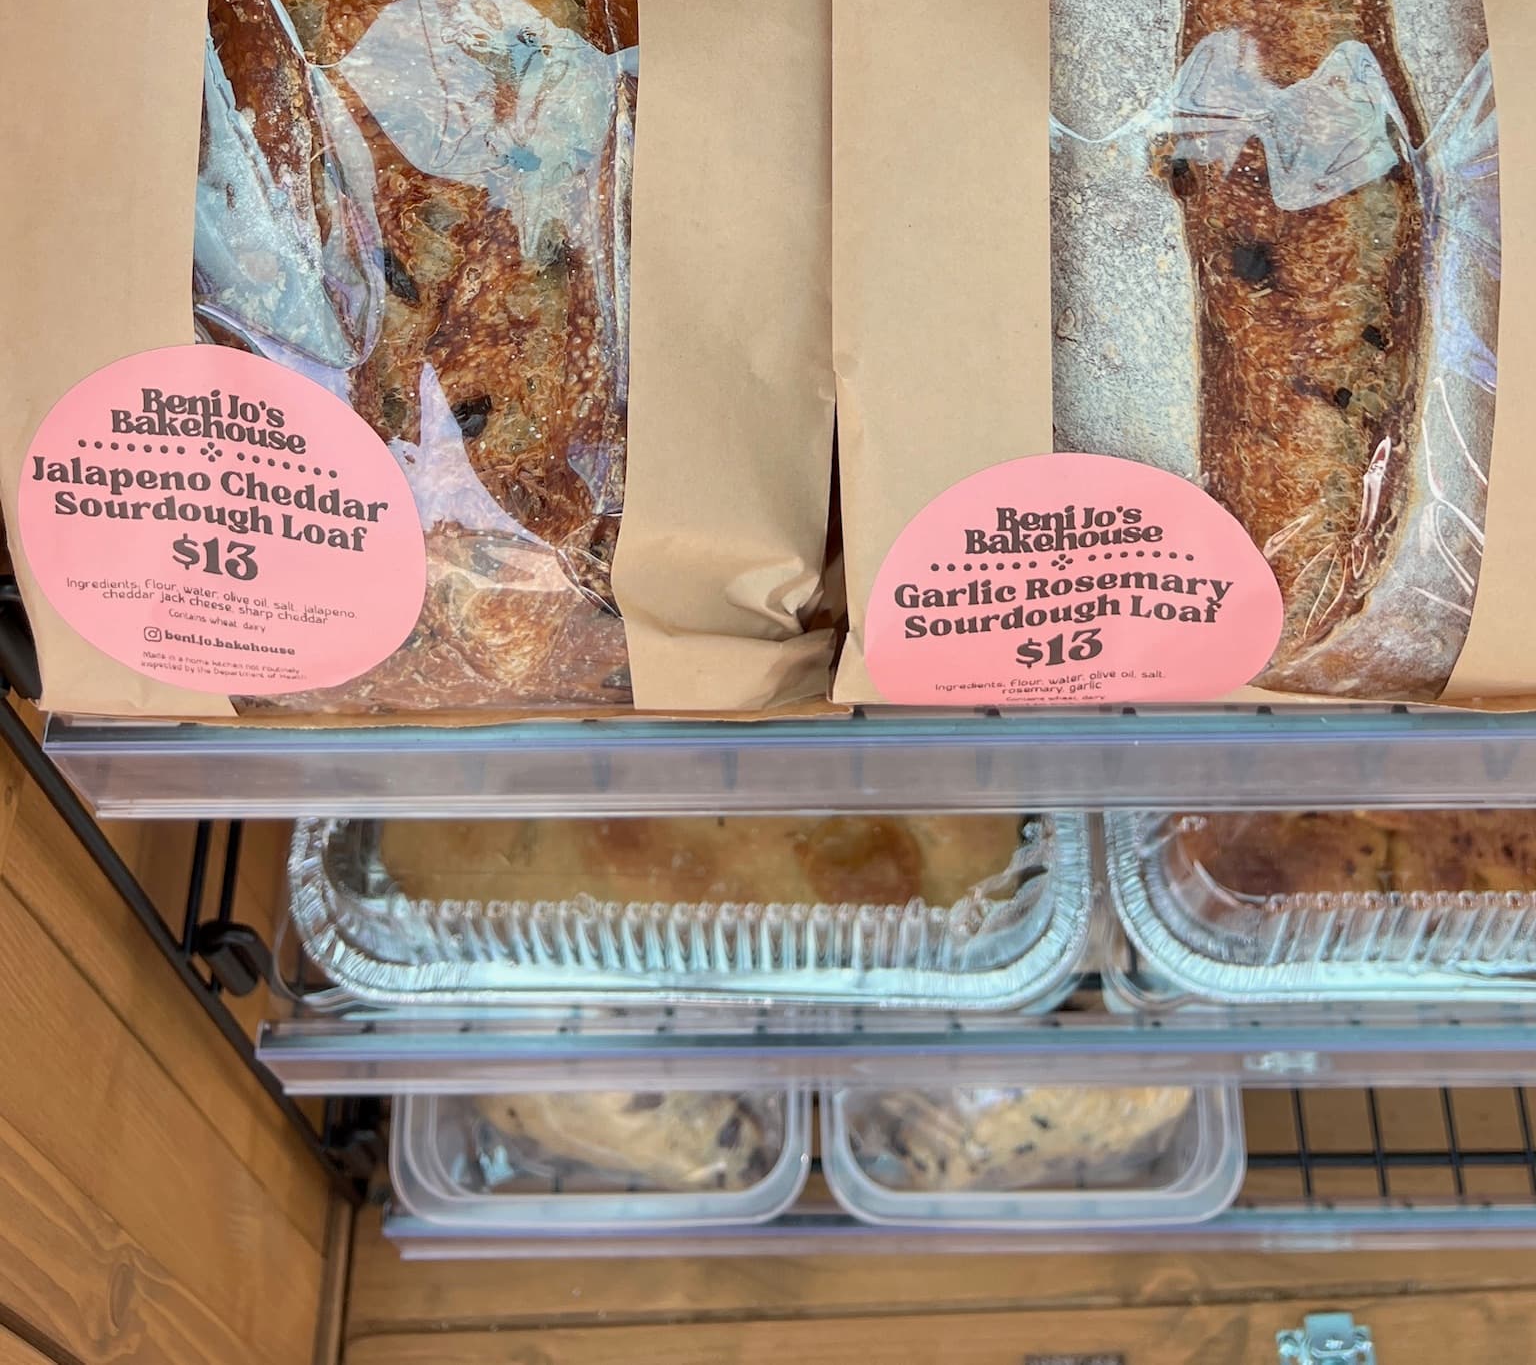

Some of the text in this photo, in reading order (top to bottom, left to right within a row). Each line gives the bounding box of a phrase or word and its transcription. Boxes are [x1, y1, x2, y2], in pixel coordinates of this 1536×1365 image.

[142, 388, 286, 428] Beni Jo's
[111, 408, 306, 455] Bakehouse
[32, 455, 389, 523] Jalapeno Cheddar
[55, 490, 368, 552] Sourdough Loaf
[996, 505, 1143, 532] Beni Jo's
[172, 533, 259, 581] $13
[964, 525, 1164, 555] Bakehouse
[102, 589, 155, 600] cheddar
[160, 592, 186, 603] jack
[238, 605, 274, 620] sharp
[277, 610, 329, 625] cheddar
[223, 591, 250, 605] olive
[894, 571, 1234, 609] Garlic Rosemary
[904, 593, 1222, 639] Sourdough Loaf
[1015, 627, 1103, 669] $13
[1069, 680, 1103, 694] garlic
[1089, 669, 1117, 681] olive
